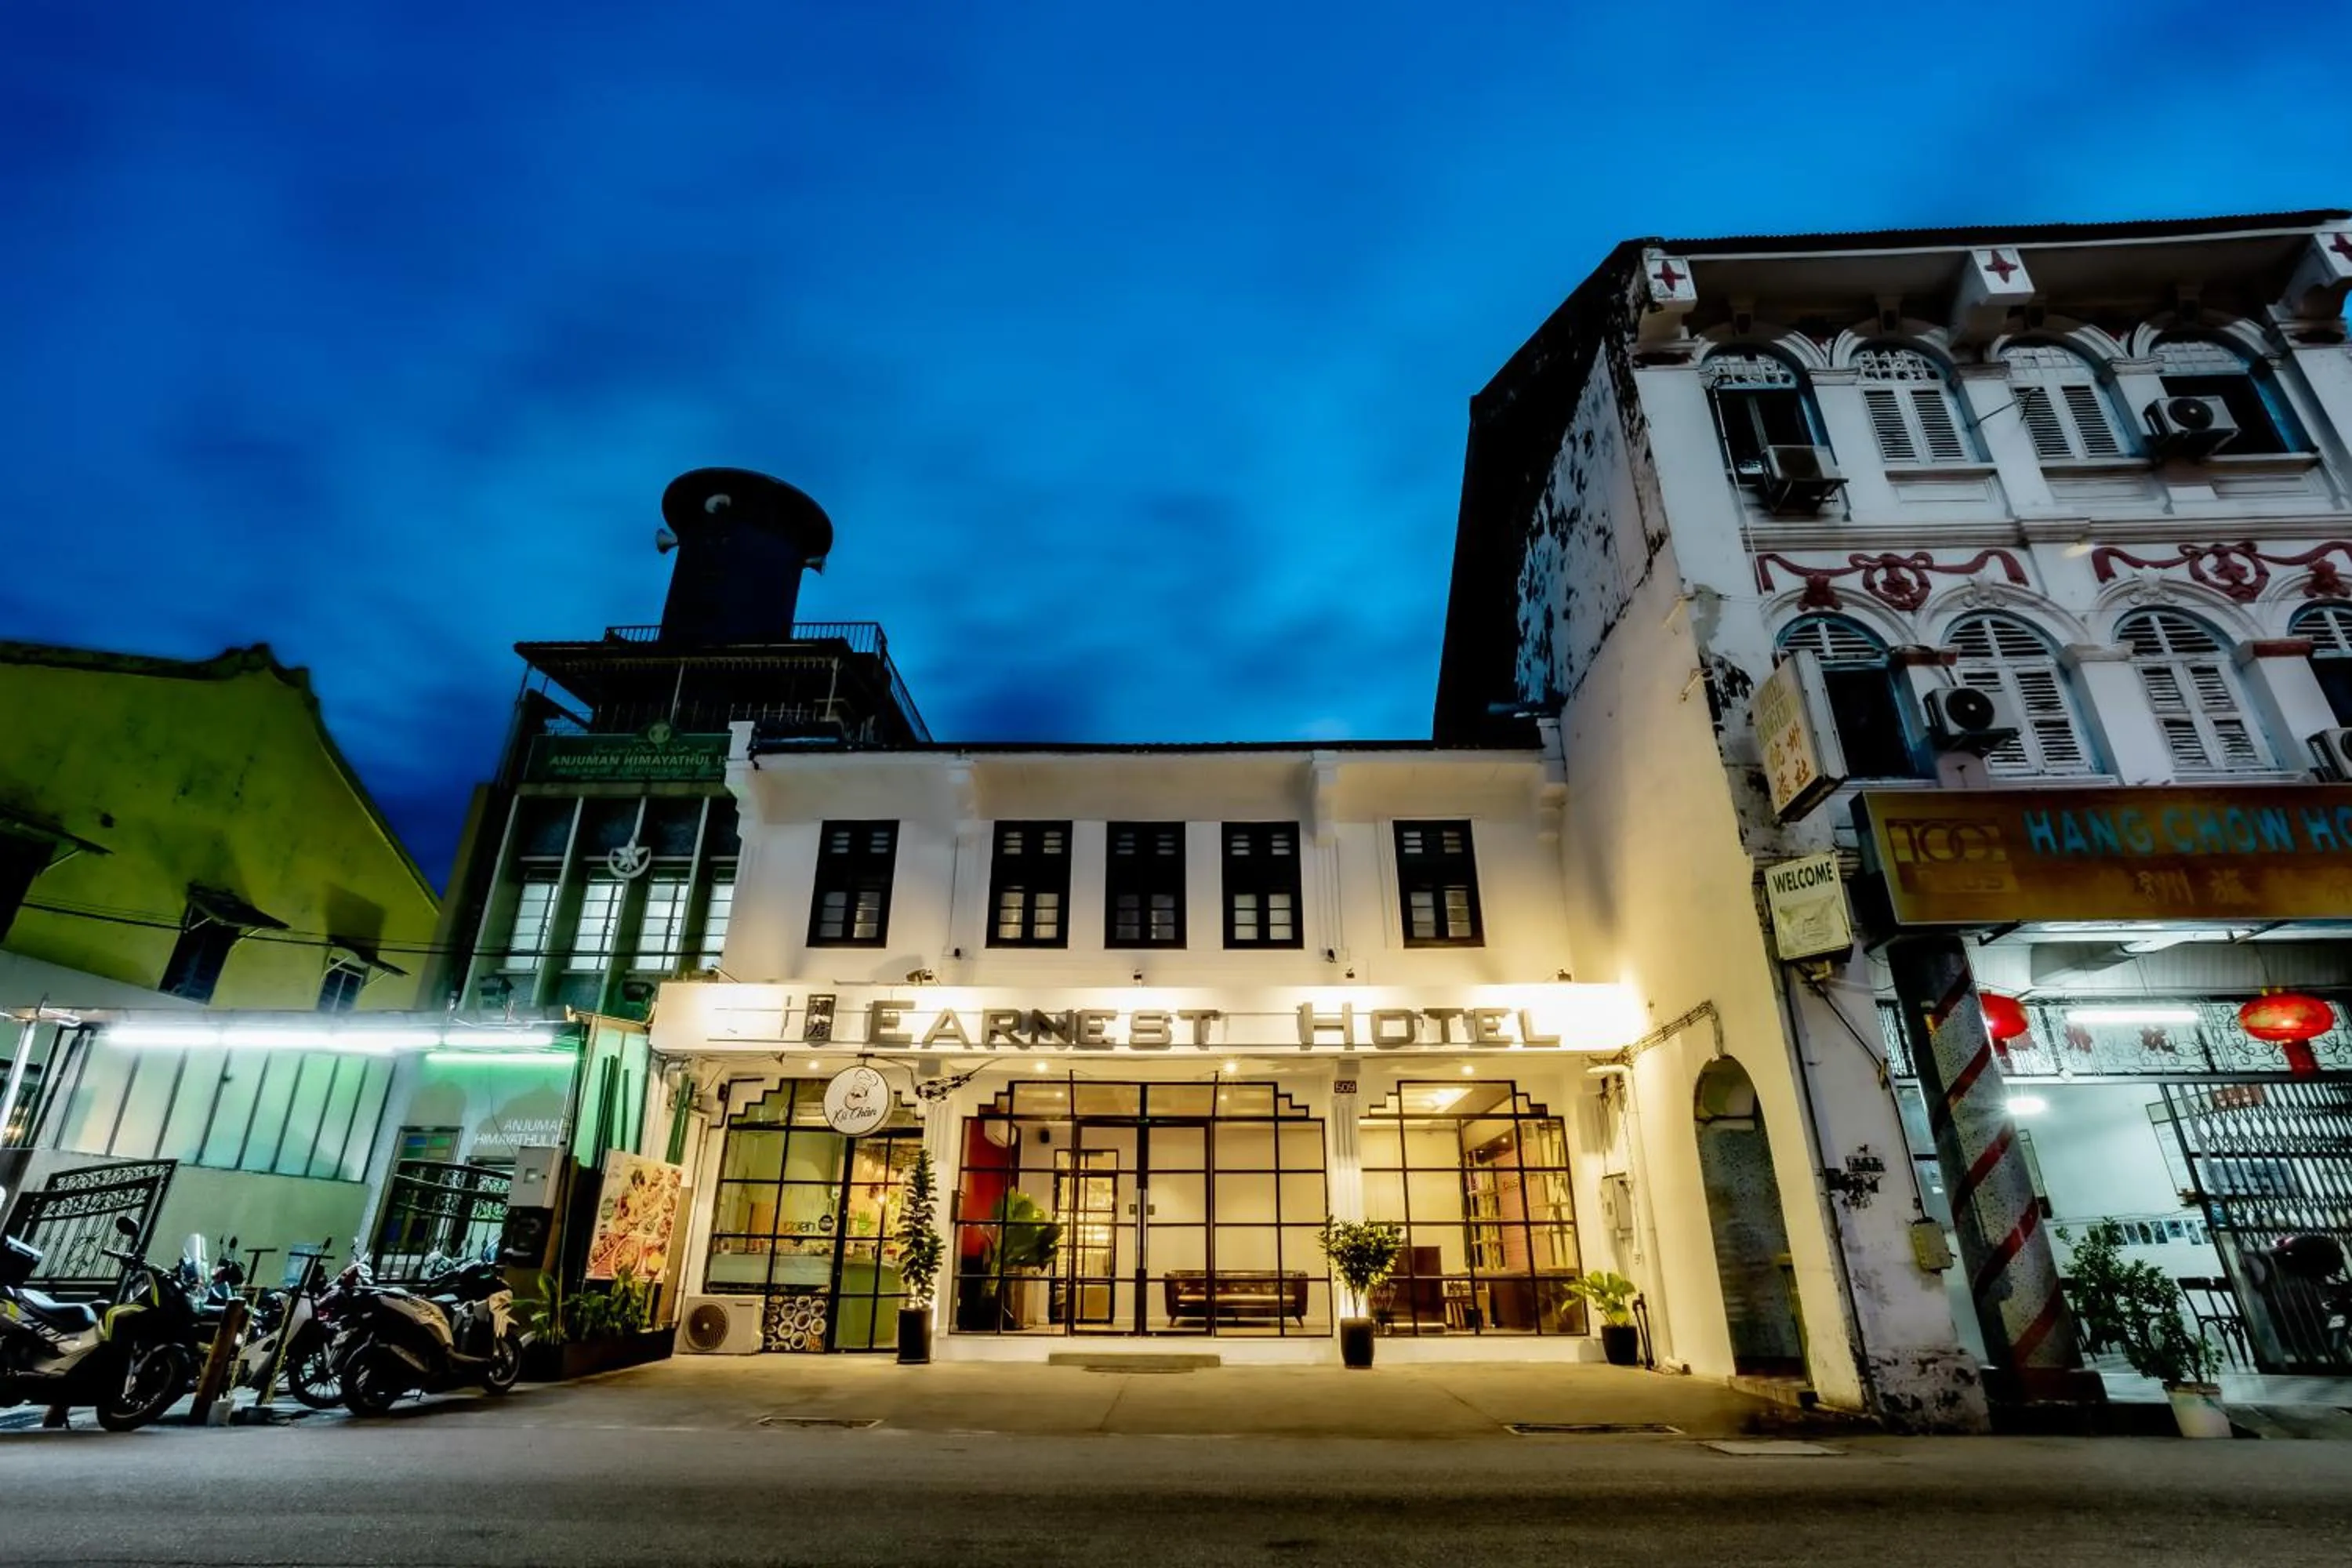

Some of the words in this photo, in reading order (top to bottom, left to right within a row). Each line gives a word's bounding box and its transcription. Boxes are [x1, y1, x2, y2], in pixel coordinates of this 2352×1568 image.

[549, 754, 621, 767] ANJUMAN
[2024, 809, 2156, 855] HANG
[2161, 807, 2297, 855] CHOW
[1773, 862, 1834, 894] WELCOME
[866, 1000, 1223, 1049] EARNEST
[1298, 1001, 1560, 1050] HOTEL
[1335, 1082, 1356, 1092] 509
[504, 1119, 561, 1132] ANJUMA
